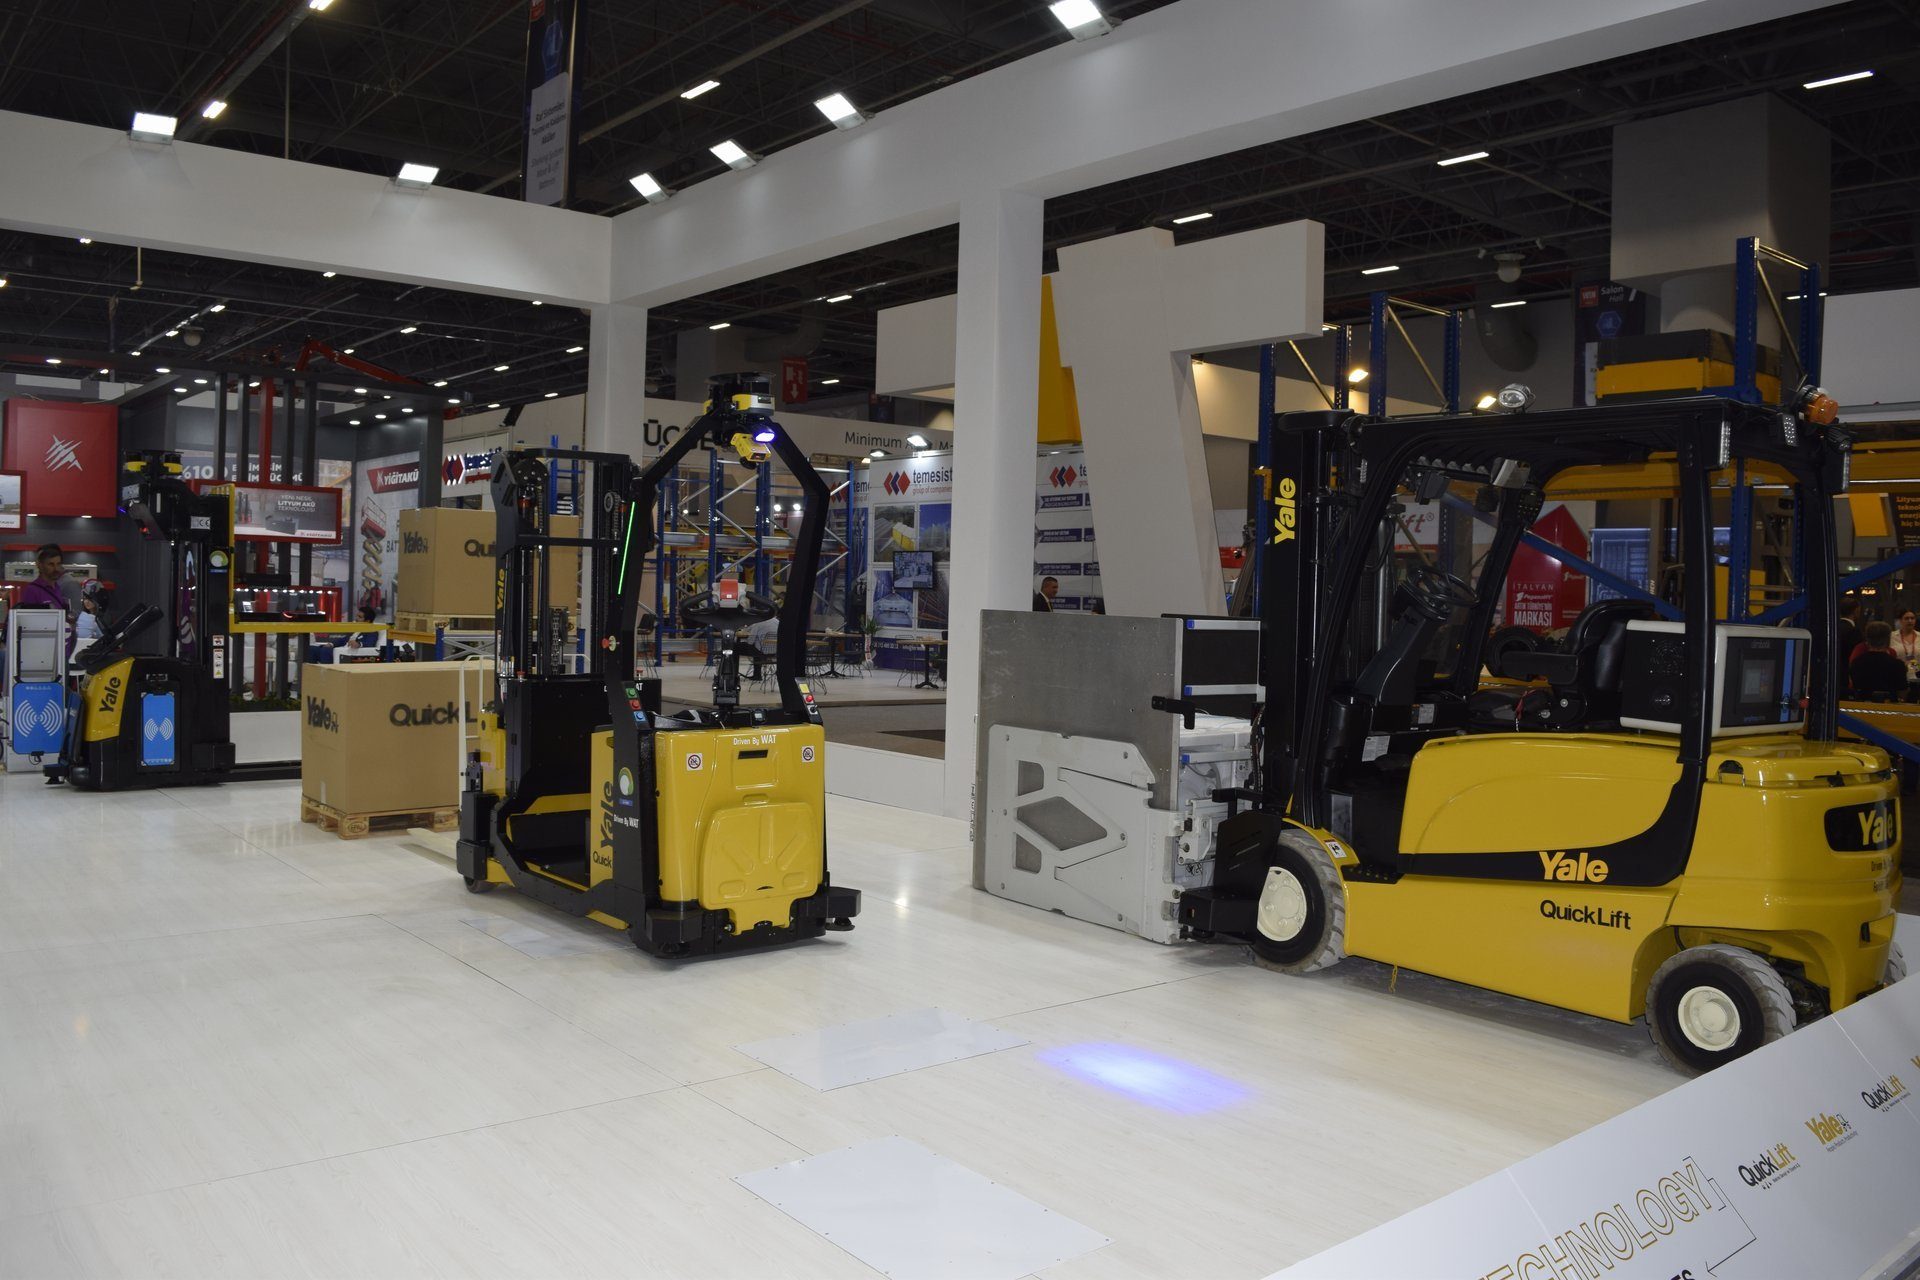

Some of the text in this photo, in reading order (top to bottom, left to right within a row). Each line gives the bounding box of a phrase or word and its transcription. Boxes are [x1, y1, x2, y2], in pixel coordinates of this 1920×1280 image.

[1600, 285, 1624, 296] Salon
[844, 431, 902, 449] Minimum
[1274, 477, 1297, 545] Yale
[1513, 611, 1553, 627] MARKASI
[98, 675, 121, 714] Yale
[306, 695, 332, 732] Yale
[733, 737, 751, 746] Driven
[760, 734, 777, 744] WAT
[1858, 809, 1894, 847] Yale
[1538, 851, 1609, 883] Yale
[1804, 1111, 1844, 1148] Yale
